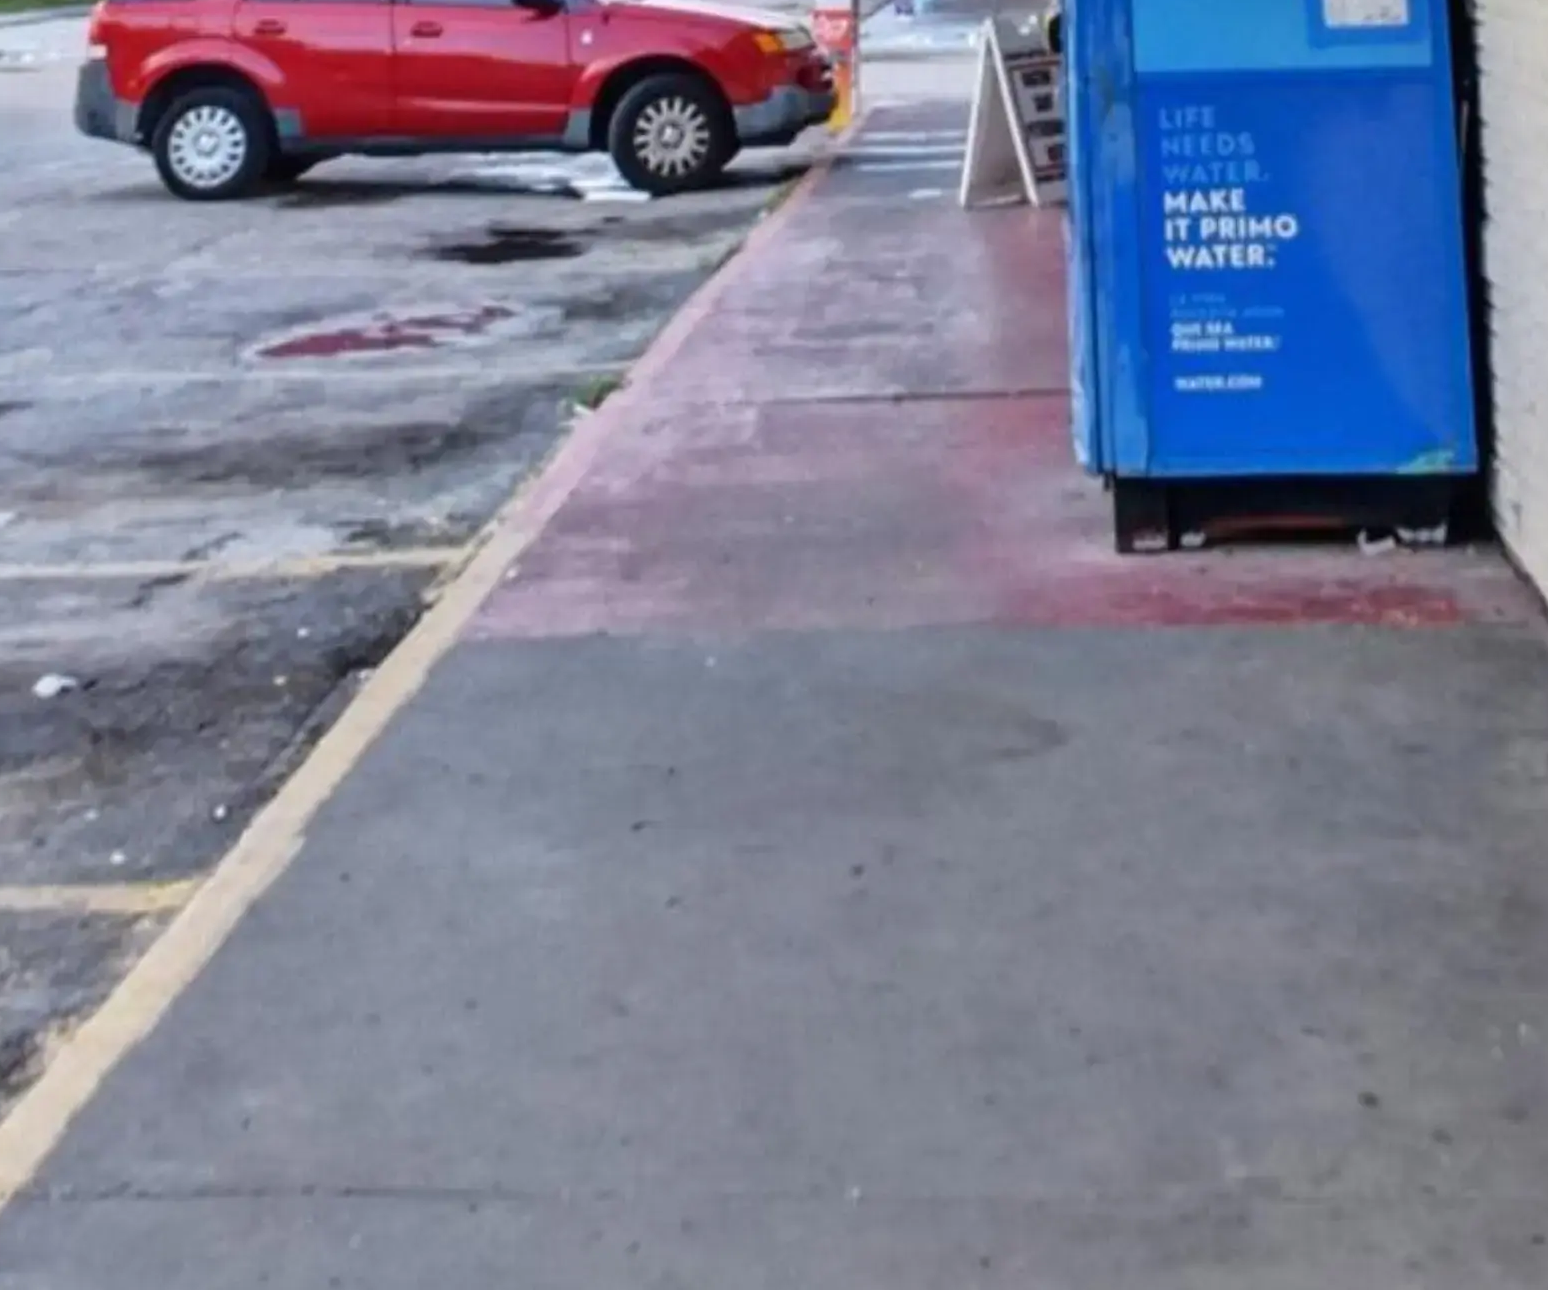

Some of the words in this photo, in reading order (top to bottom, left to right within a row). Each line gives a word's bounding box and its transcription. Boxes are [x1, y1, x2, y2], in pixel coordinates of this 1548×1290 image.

[1158, 105, 1215, 131] LIFE
[1160, 130, 1256, 158] NEEDS
[1164, 186, 1246, 214] MAKE
[1164, 216, 1191, 242] IT
[1199, 212, 1299, 240] PRIMO
